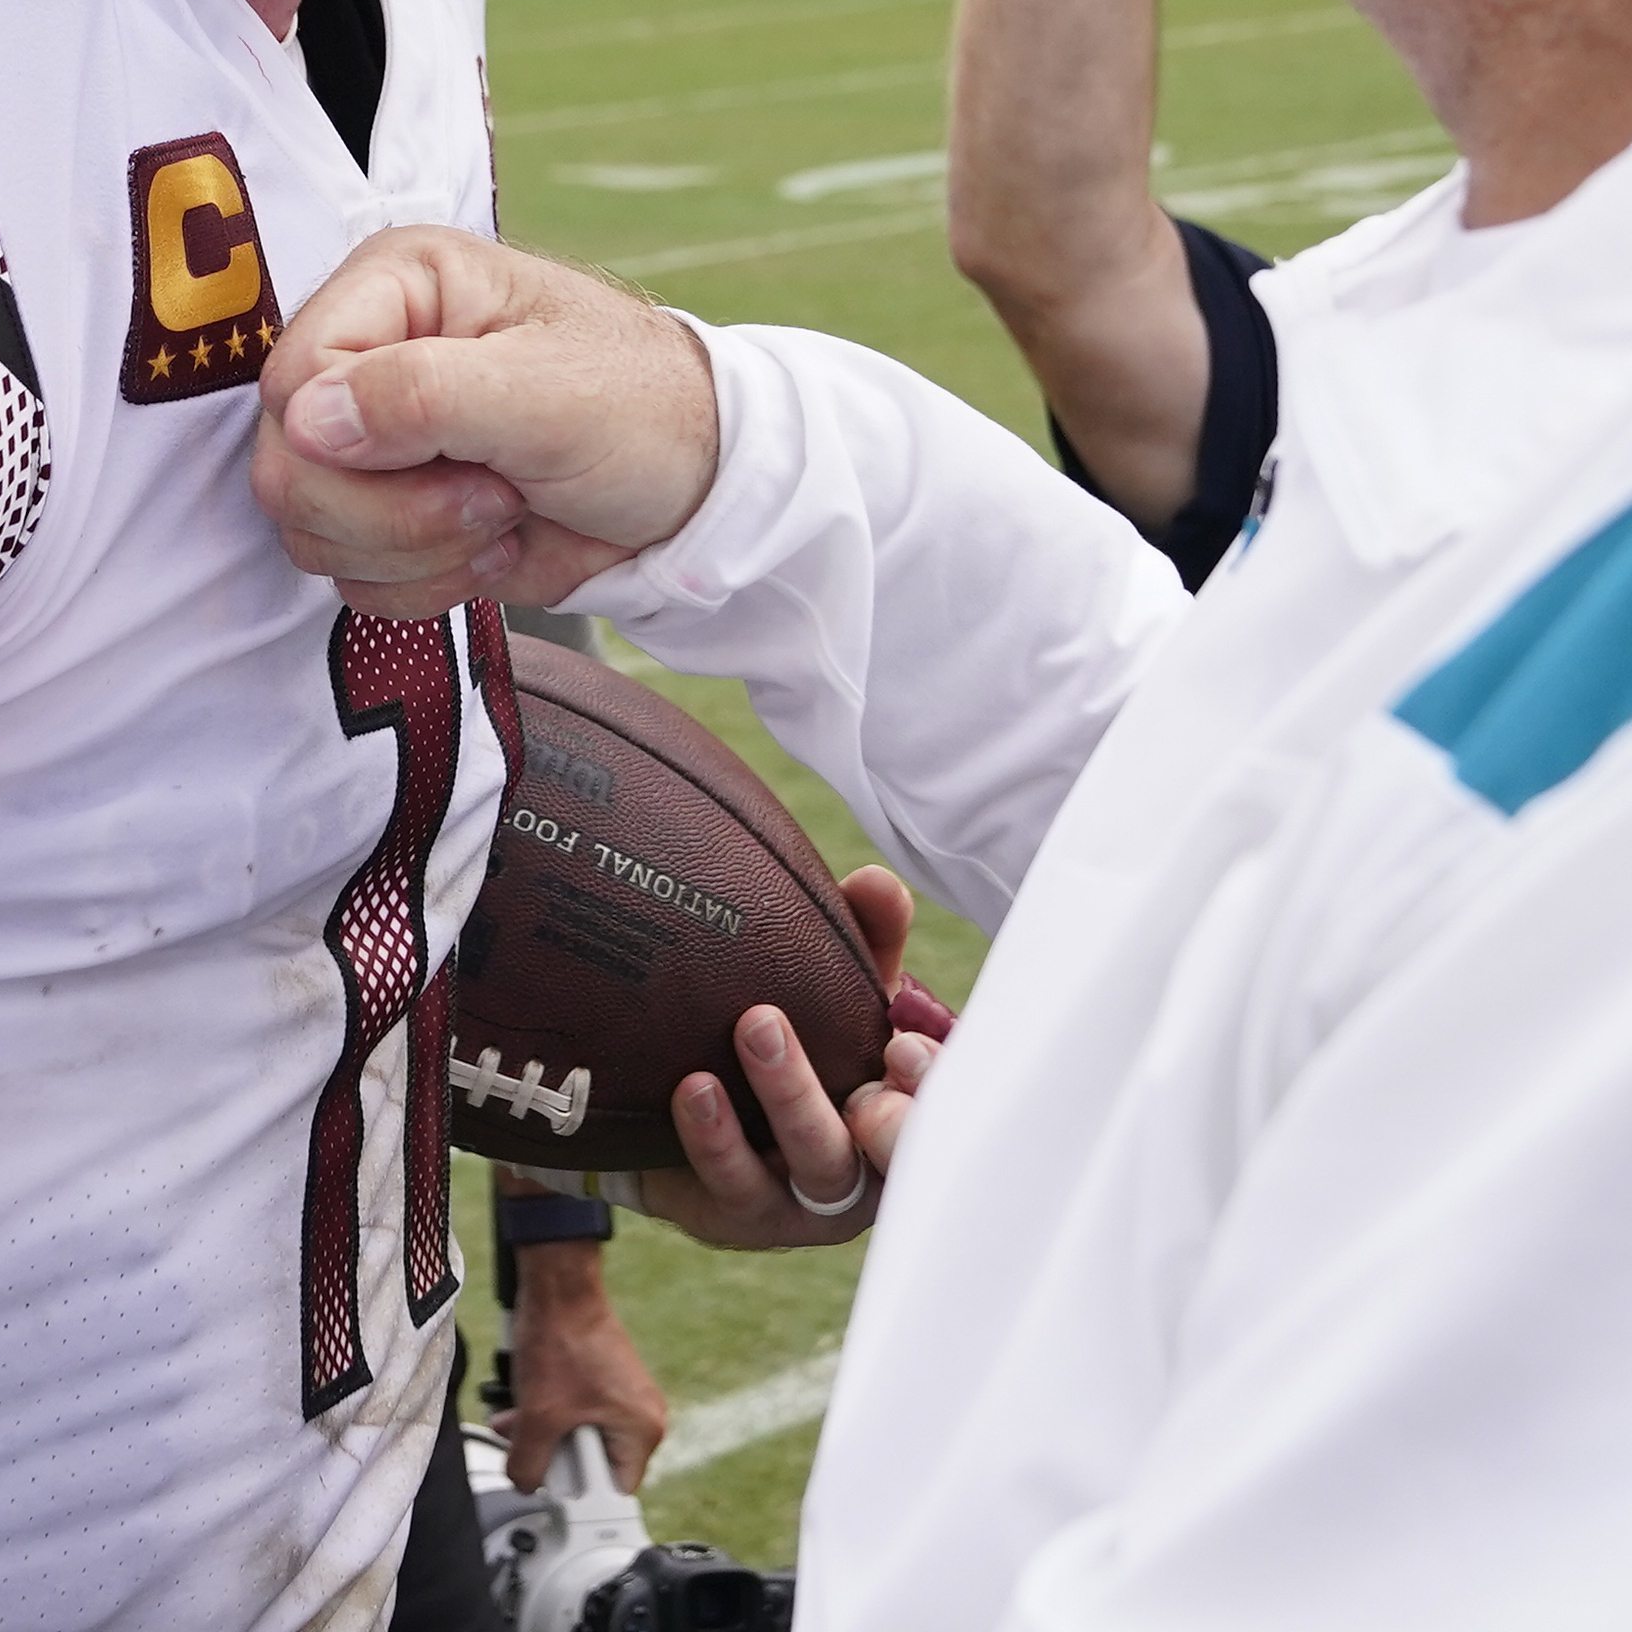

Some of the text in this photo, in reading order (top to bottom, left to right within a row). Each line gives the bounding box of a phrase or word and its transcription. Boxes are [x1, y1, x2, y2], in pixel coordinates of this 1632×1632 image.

[148, 153, 261, 332] C
[504, 809, 581, 853] FOO
[594, 842, 742, 936] NATIONAL
